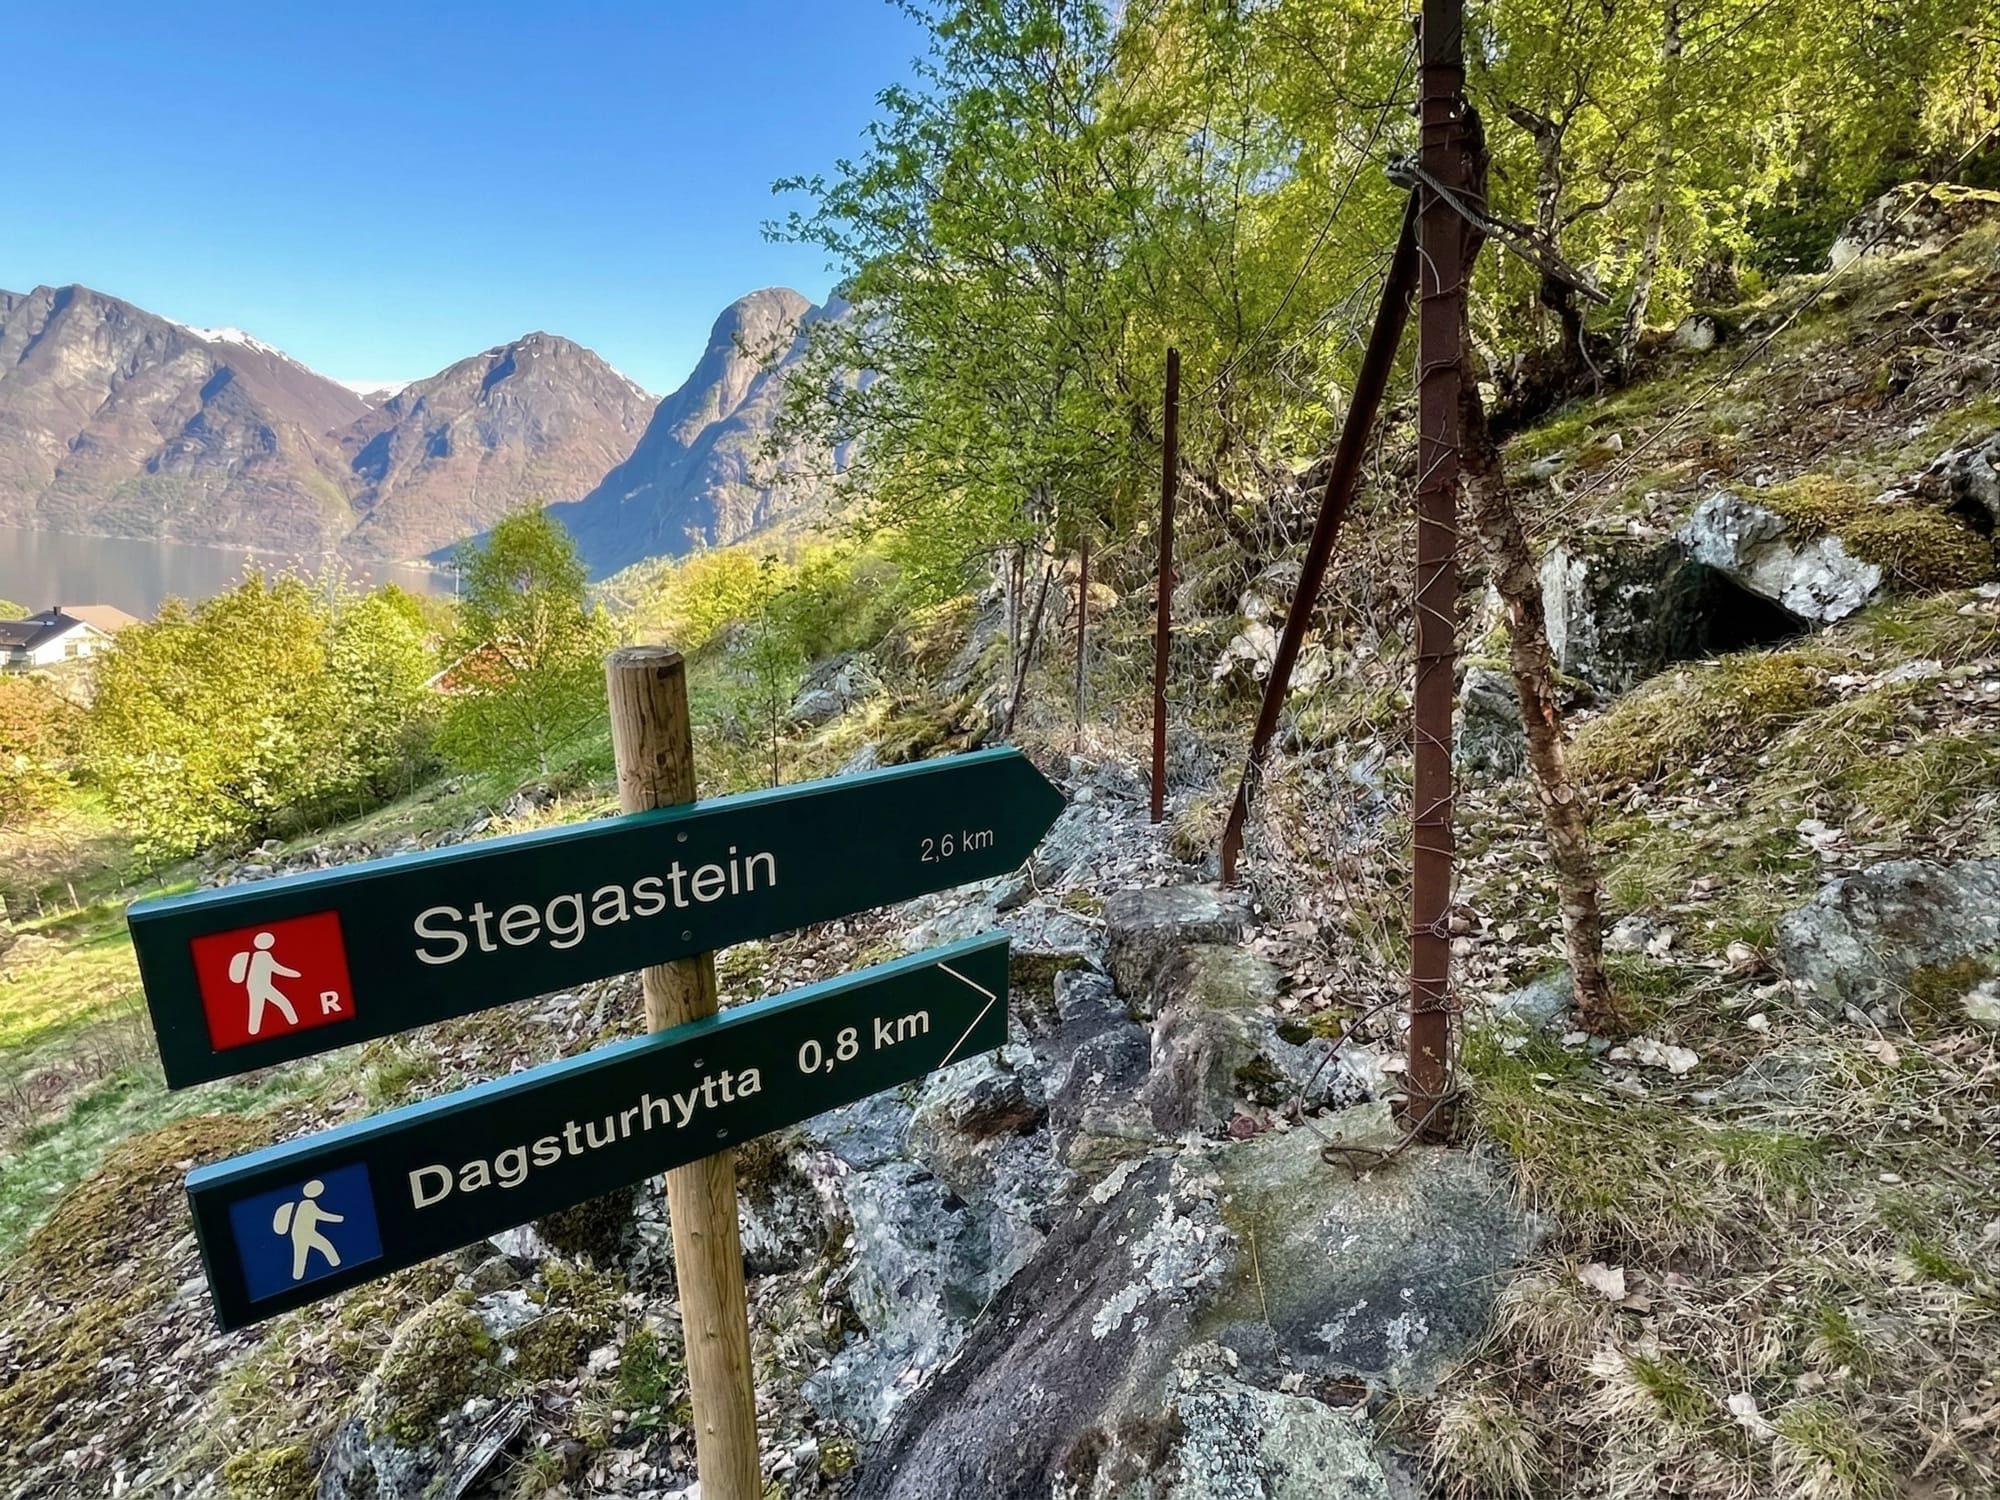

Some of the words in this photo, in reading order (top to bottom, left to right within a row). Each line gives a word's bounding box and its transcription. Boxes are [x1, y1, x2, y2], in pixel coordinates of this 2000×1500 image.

[413, 846, 778, 965] Stegastein
[920, 834, 955, 864] 2,6
[962, 829, 994, 852] km
[319, 991, 342, 1015] R
[409, 1066, 764, 1210] Dagsturhytta
[797, 1026, 861, 1074] 0,8
[873, 1009, 930, 1051] km
